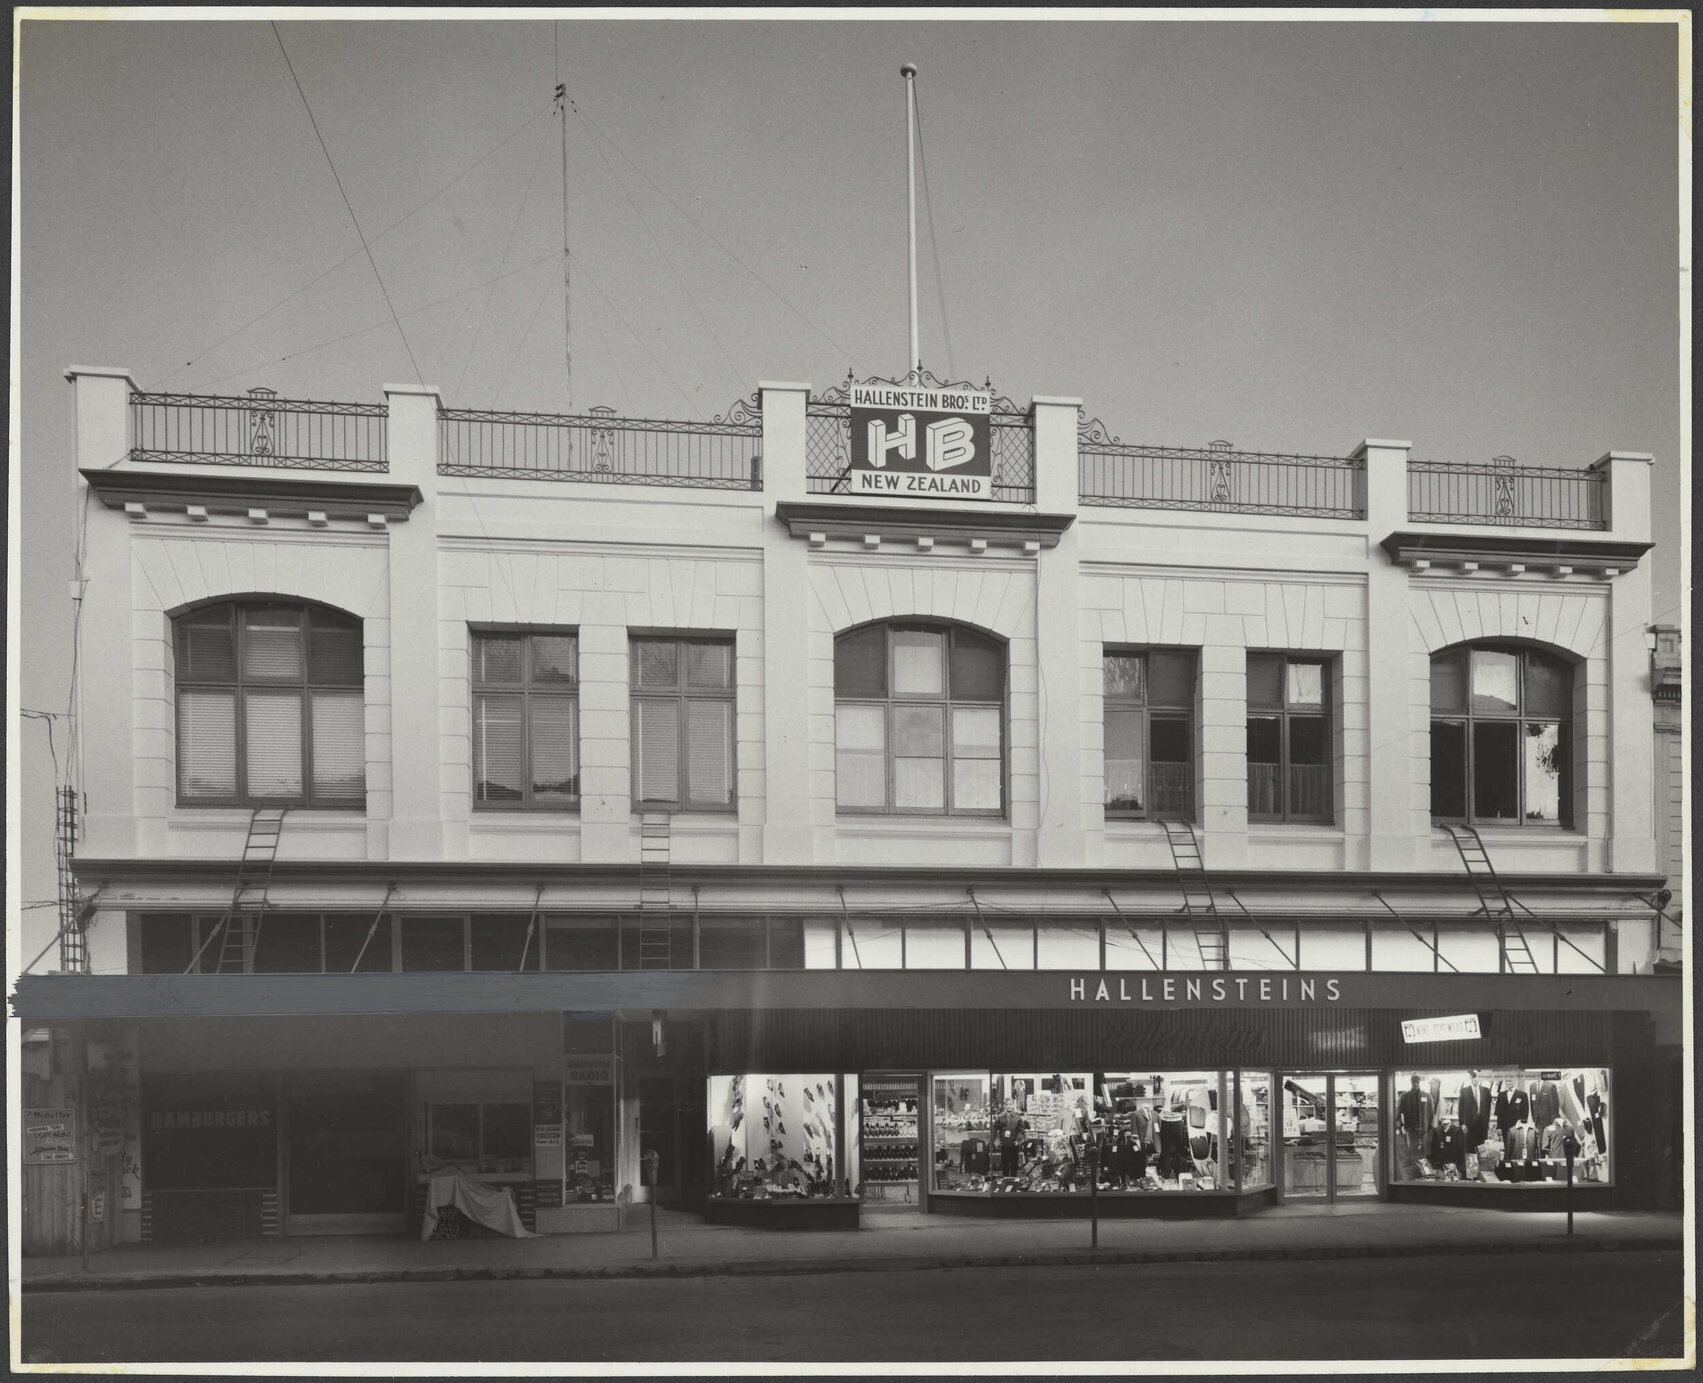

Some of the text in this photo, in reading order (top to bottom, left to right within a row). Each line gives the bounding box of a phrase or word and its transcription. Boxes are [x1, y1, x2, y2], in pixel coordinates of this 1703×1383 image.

[854, 389, 938, 408] HALLENSTEIN
[867, 413, 976, 472] HB
[862, 474, 981, 493] NEW ZEALAND
[1070, 978, 1341, 1001] HALLENSTEINS
[570, 1070, 609, 1081] RADIO
[150, 1110, 271, 1129] HAMBURGERS
